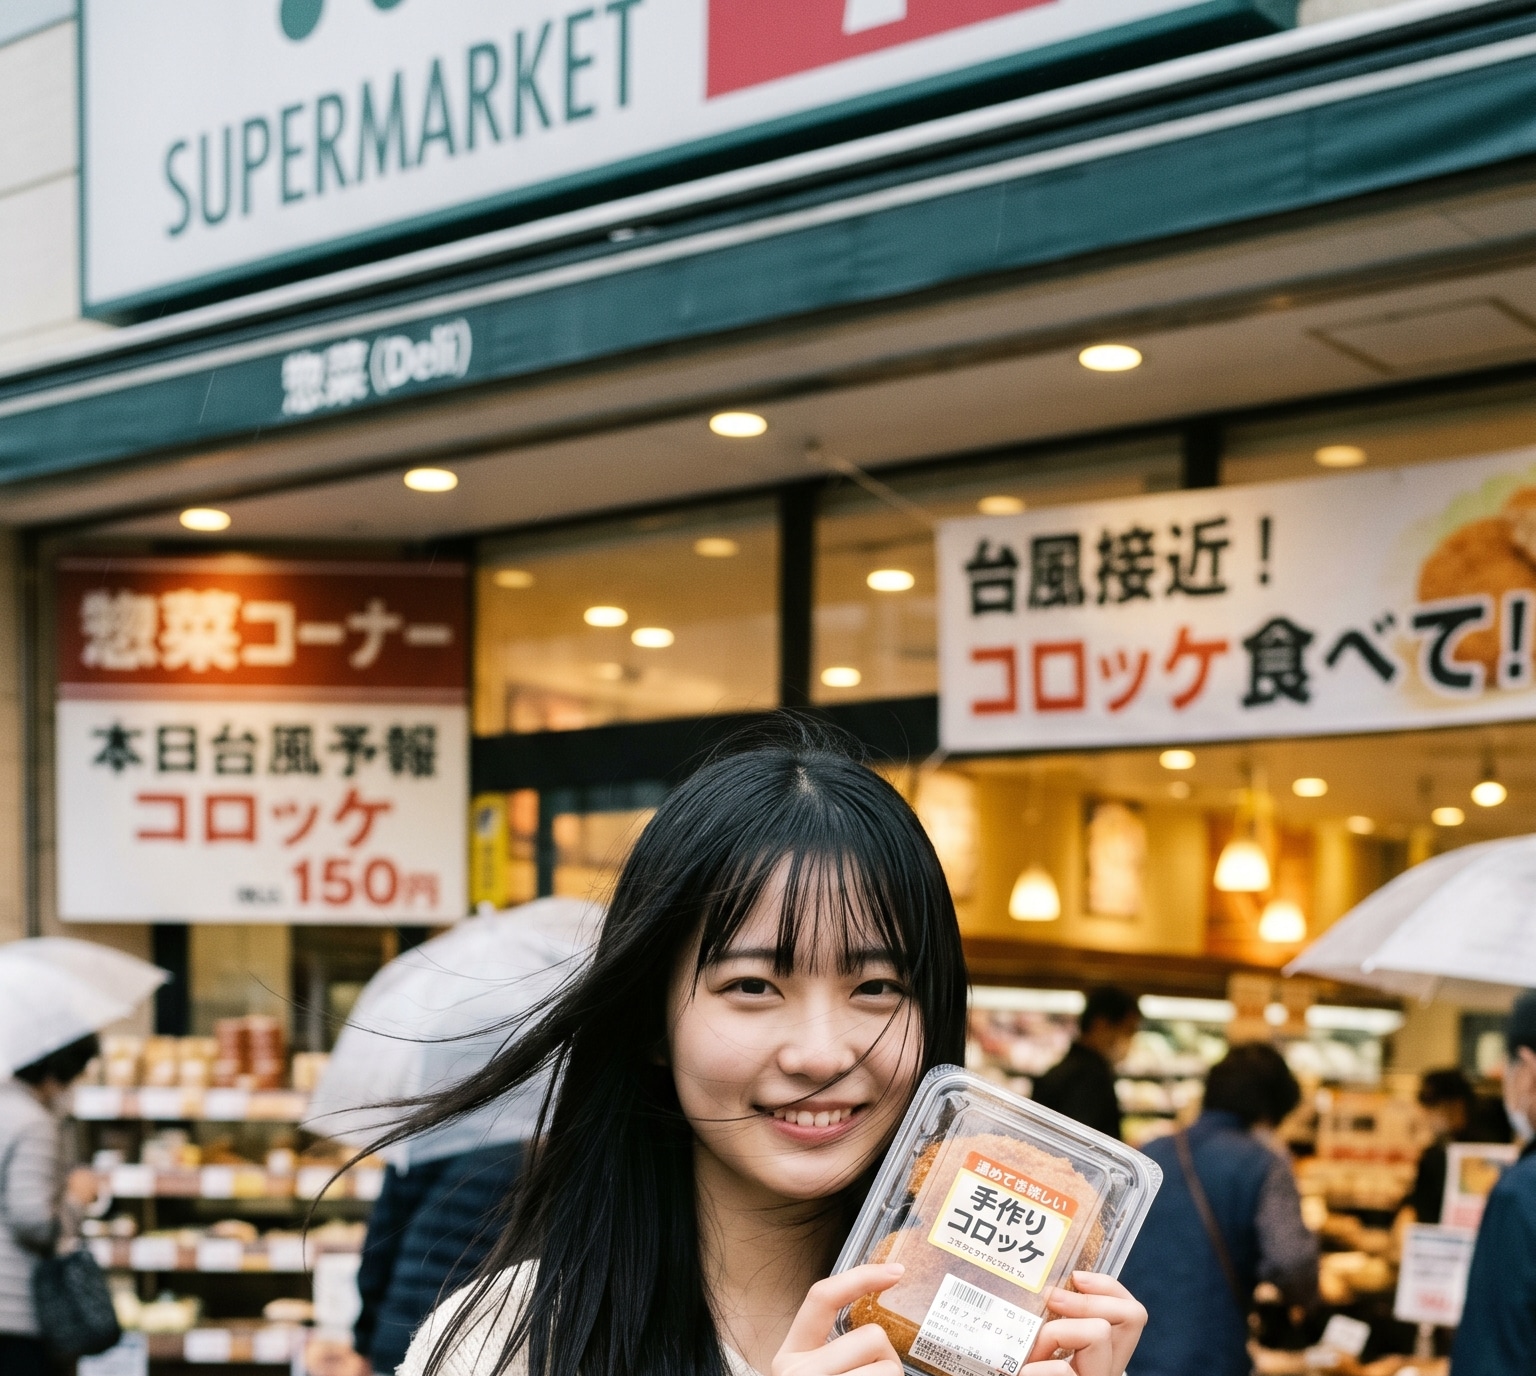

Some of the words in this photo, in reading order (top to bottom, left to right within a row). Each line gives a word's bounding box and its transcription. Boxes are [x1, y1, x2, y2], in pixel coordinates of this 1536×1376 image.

[163, 0, 643, 238] SUPERMARKET
[966, 515, 1273, 616] 台風接近！
[134, 786, 392, 849] コロッケ
[947, 1208, 1046, 1264] コロッケ
[970, 1185, 1047, 1236] 手作り
